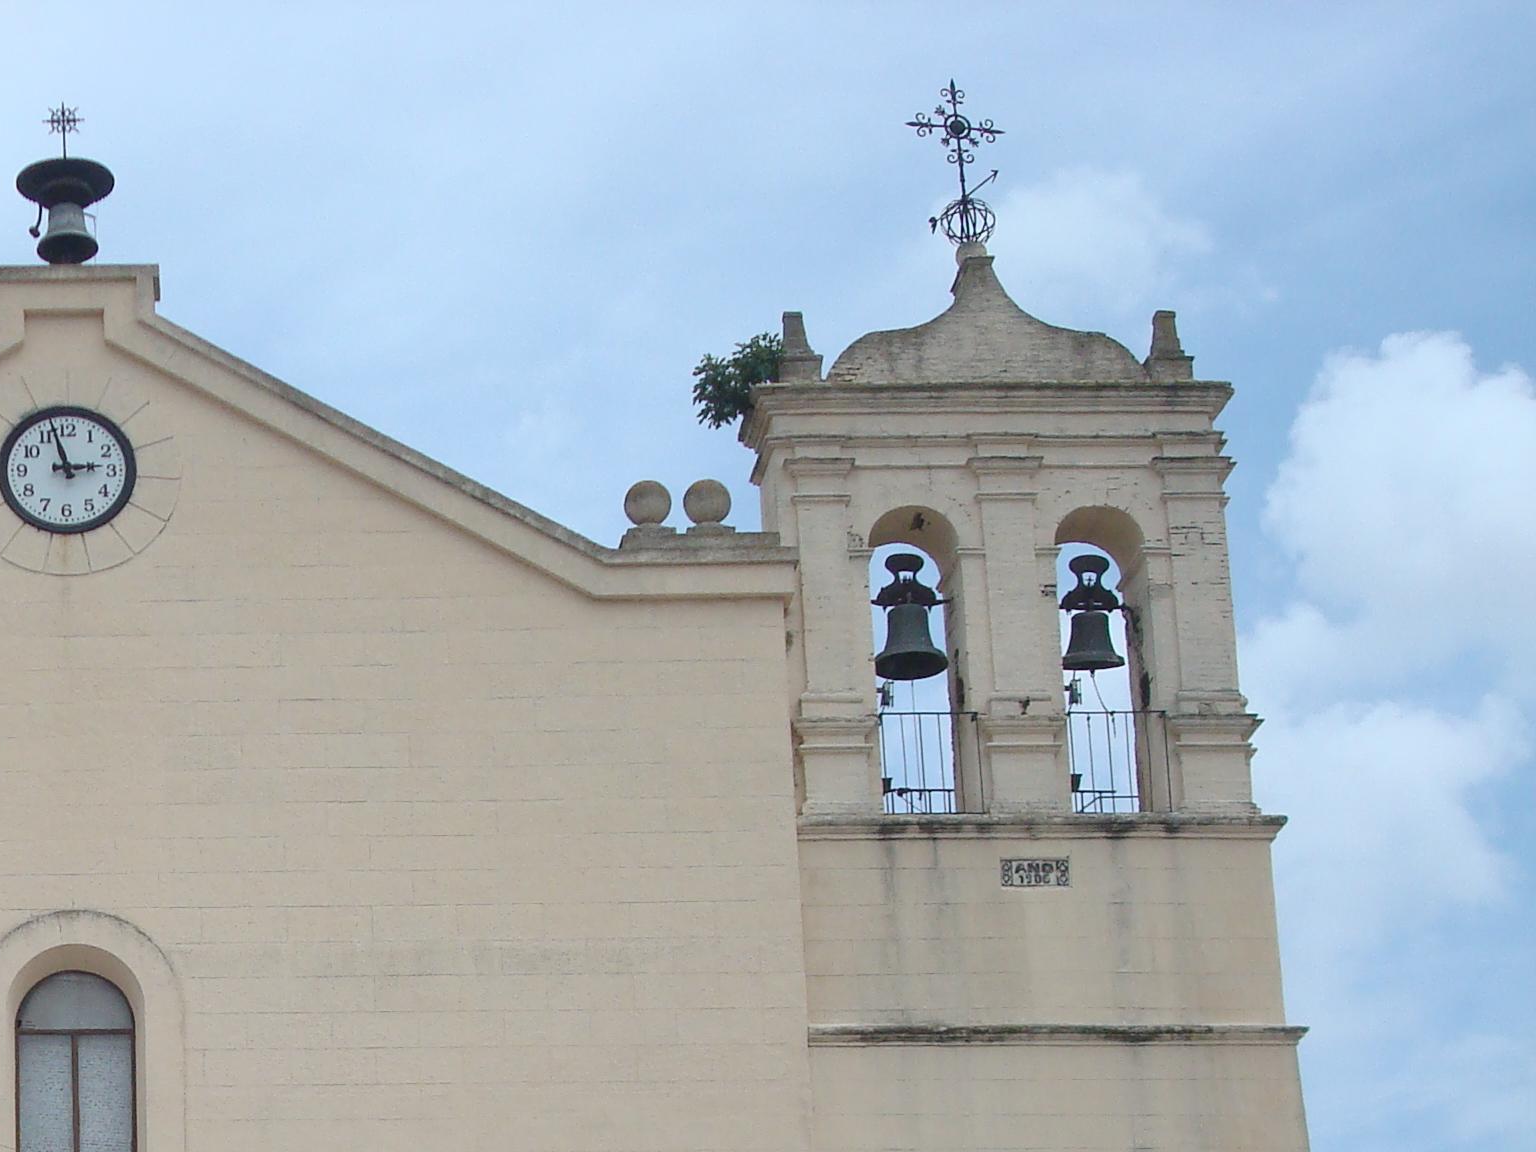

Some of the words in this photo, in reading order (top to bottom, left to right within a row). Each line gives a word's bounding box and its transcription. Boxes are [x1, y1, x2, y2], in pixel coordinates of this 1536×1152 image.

[39, 430, 53, 443] 11
[59, 424, 76, 437] 12
[87, 430, 93, 443] 1
[24, 444, 40, 458] 10
[101, 444, 112, 457] 2
[16, 464, 28, 478] 9
[106, 464, 117, 478] 3
[23, 484, 35, 497] 8
[98, 484, 110, 497] 4
[39, 498, 51, 512] 7
[61, 504, 72, 517] 6
[83, 499, 95, 512] 5
